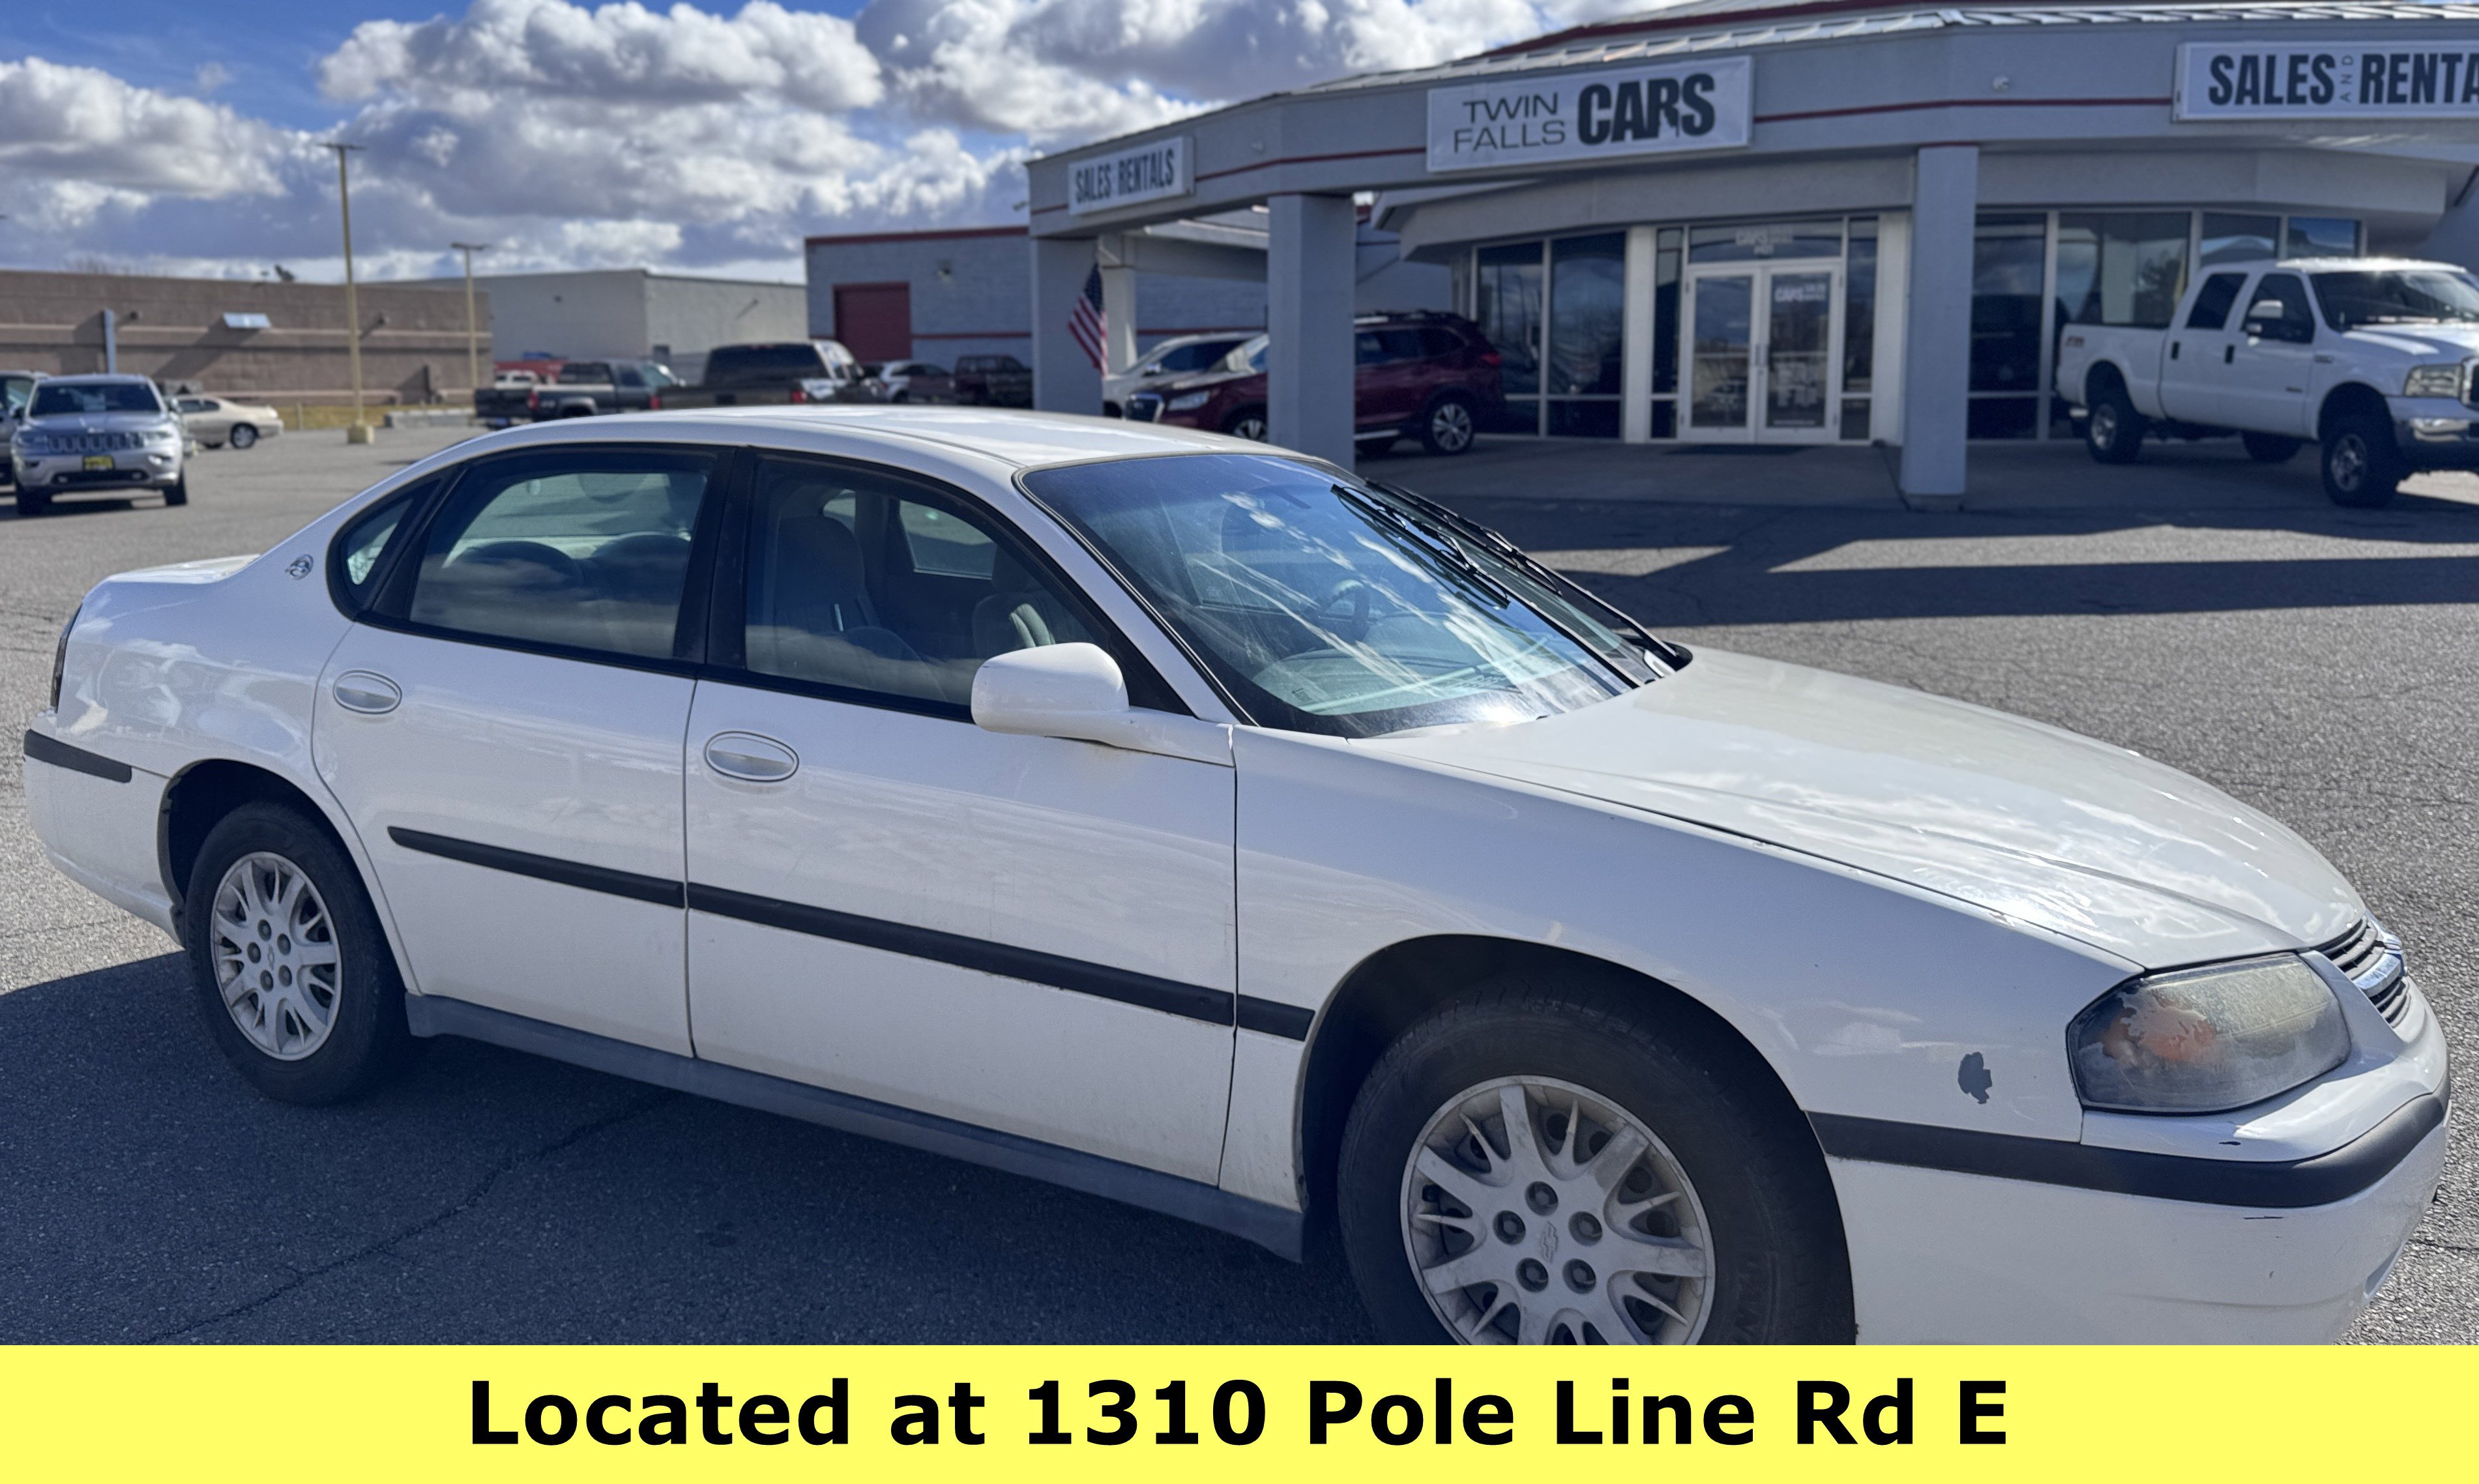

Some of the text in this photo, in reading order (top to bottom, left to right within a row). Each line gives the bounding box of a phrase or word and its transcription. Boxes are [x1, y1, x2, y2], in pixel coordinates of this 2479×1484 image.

[2208, 53, 2336, 106] SALES
[1463, 93, 1559, 124] TWIN
[1577, 73, 1716, 145] CARS
[1454, 120, 1566, 153] FALLS
[1076, 163, 1111, 204] SALES
[1118, 148, 1175, 196] RENTALS
